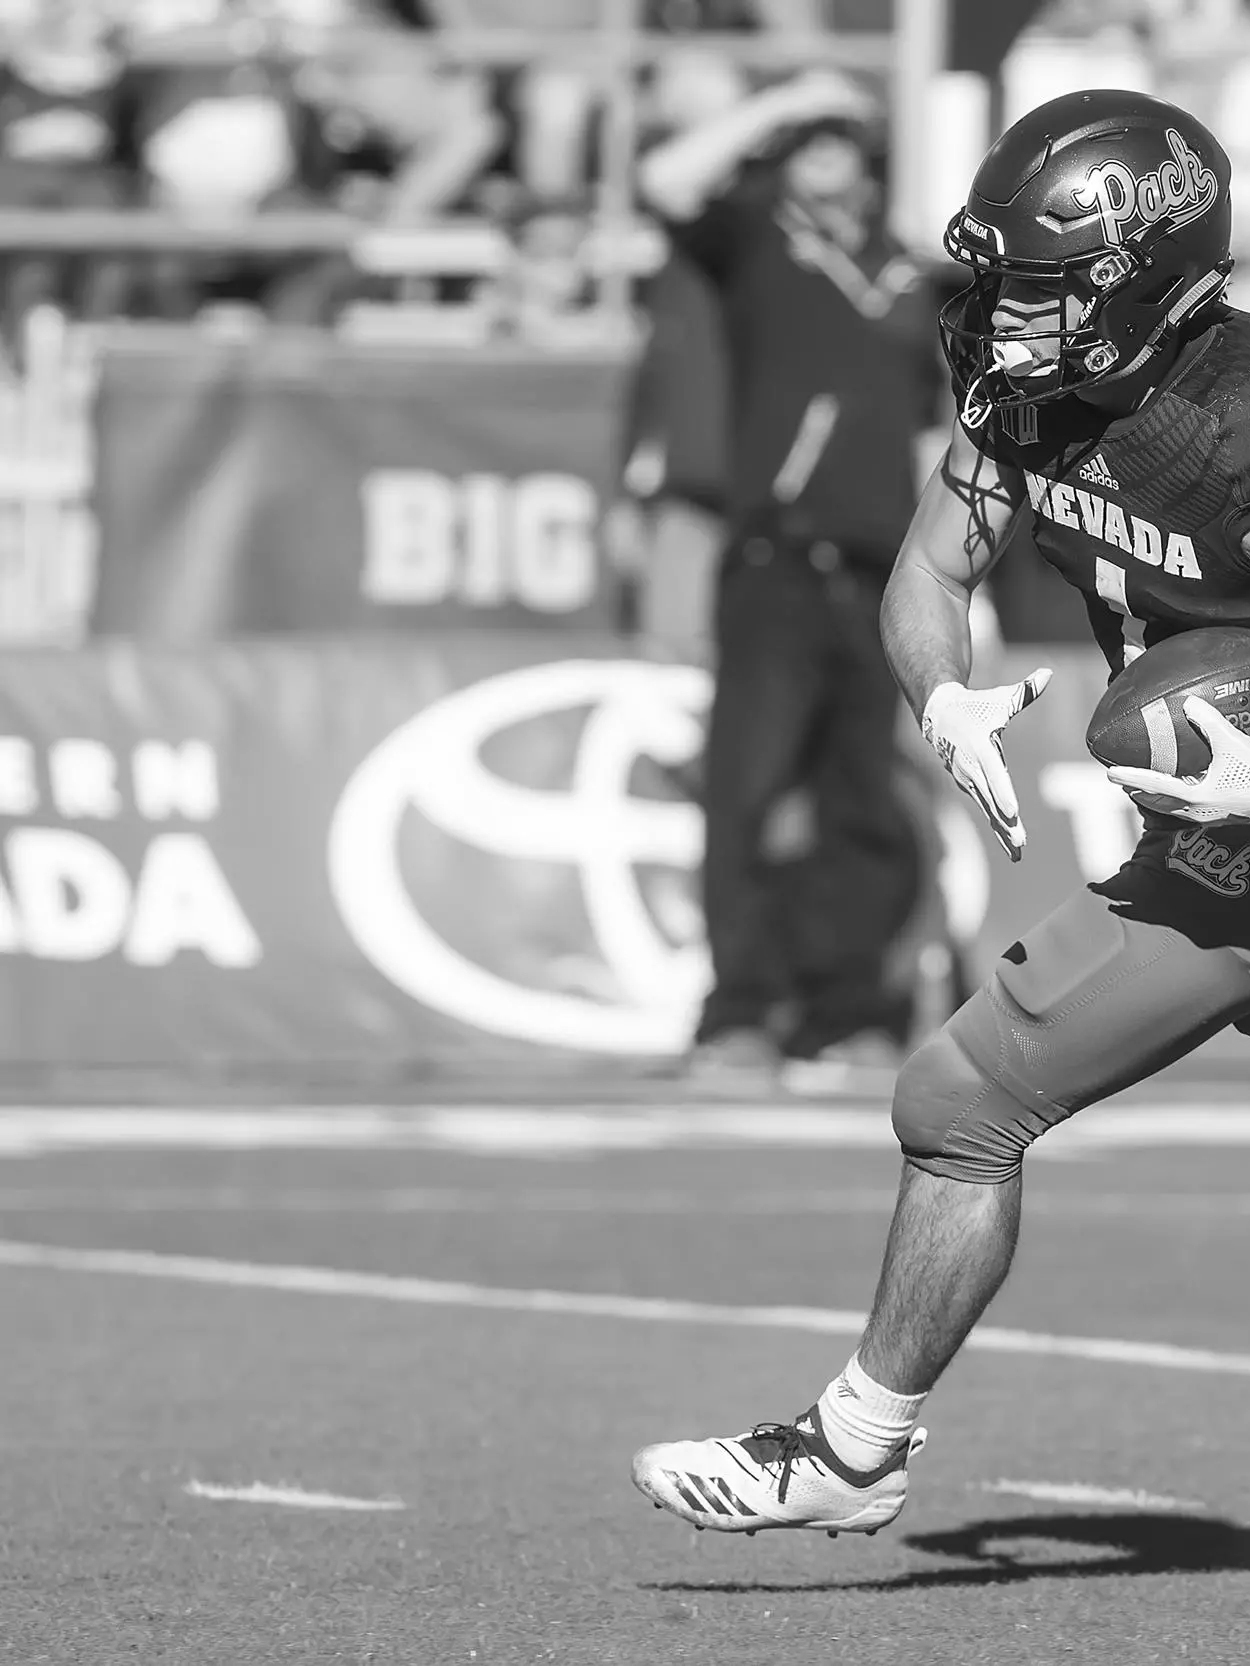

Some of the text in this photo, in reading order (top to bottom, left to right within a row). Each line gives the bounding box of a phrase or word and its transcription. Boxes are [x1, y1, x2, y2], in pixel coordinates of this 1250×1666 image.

[1071, 127, 1219, 249] Pack
[358, 468, 598, 612] BIG
[1023, 468, 1202, 580] NEVADA
[1079, 468, 1120, 491] adidas
[0, 826, 263, 968] DA
